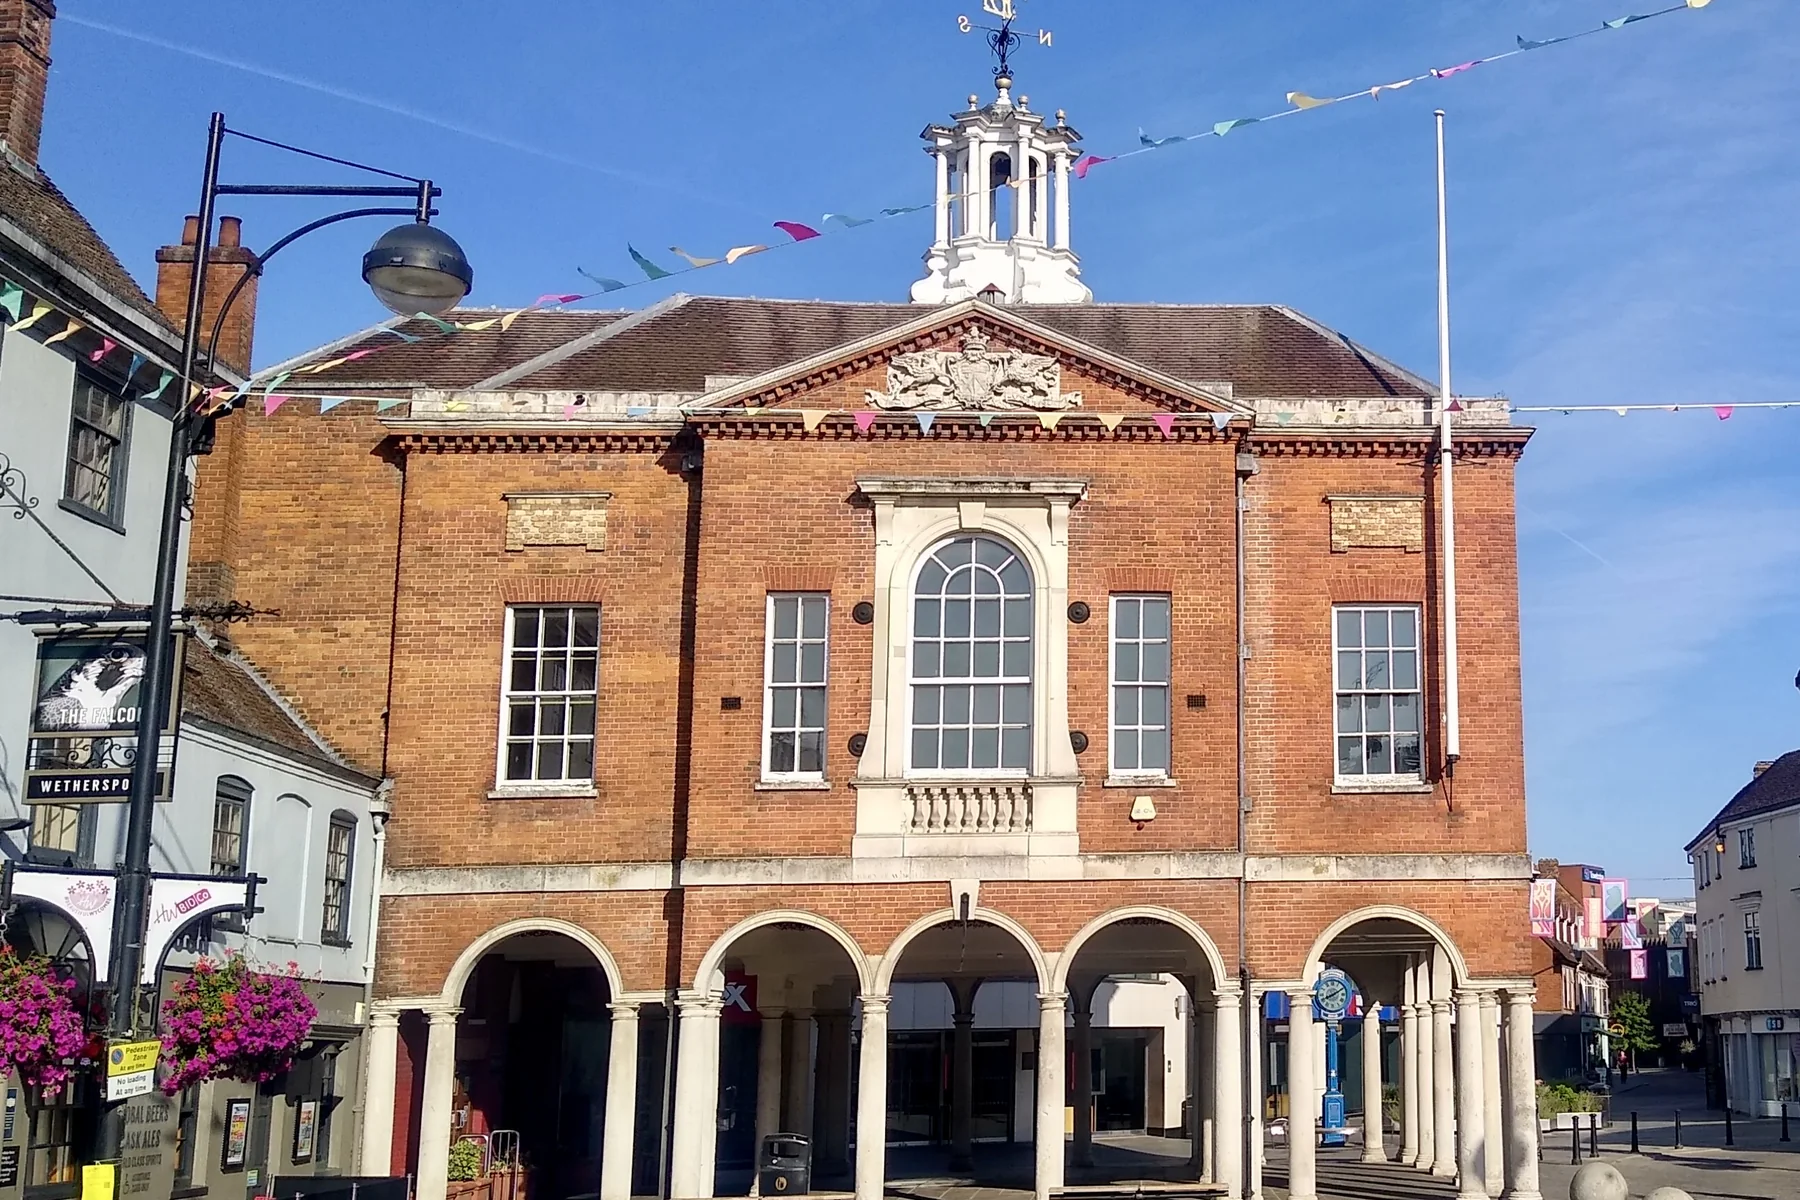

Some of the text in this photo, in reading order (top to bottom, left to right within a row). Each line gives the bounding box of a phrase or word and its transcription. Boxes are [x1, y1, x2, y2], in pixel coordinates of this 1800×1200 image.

[60, 709, 86, 724] THE
[41, 778, 130, 793] WETHERSPO
[1767, 1019, 1781, 1029] TSB
[126, 1044, 158, 1054] Pedestrian
[127, 1075, 146, 1084] loading
[125, 1104, 169, 1124] OBAL BEERS
[126, 1129, 161, 1149] ASK ALES
